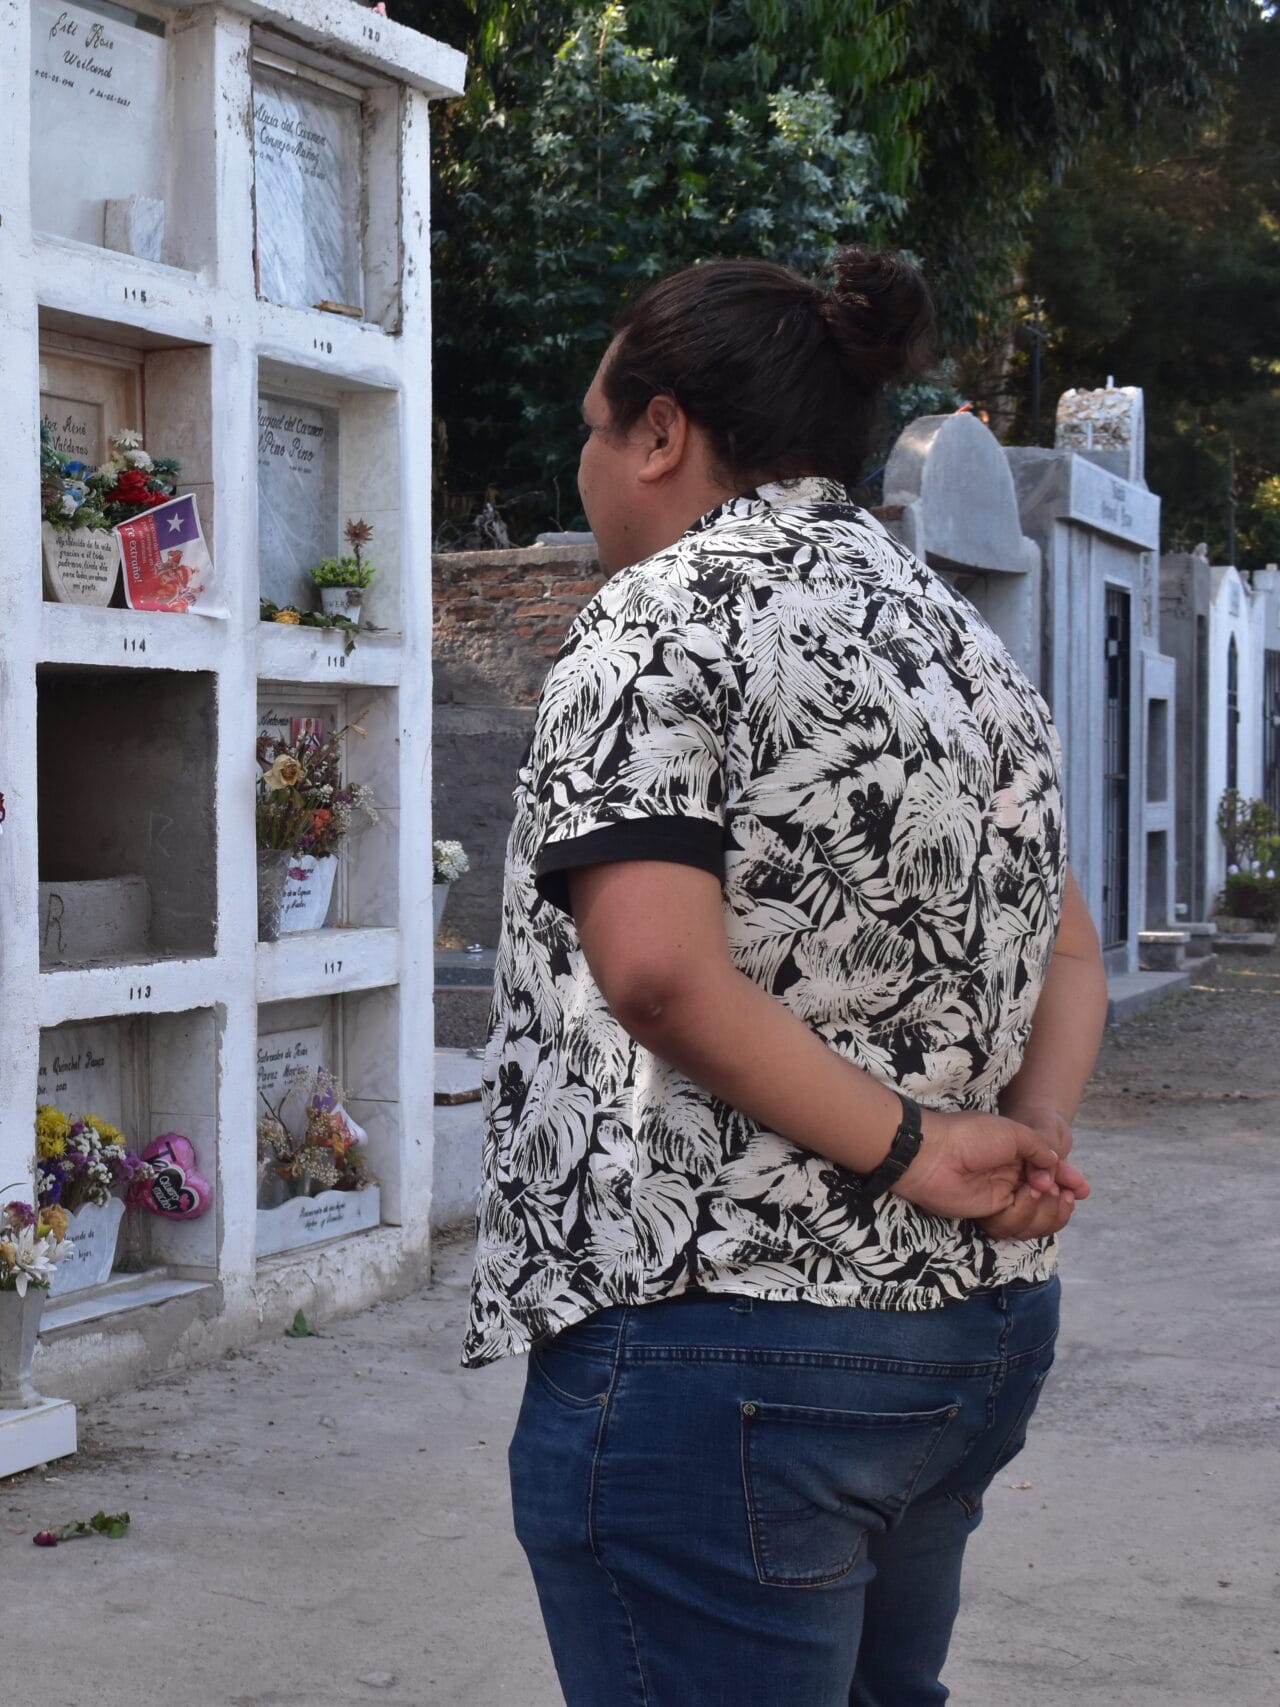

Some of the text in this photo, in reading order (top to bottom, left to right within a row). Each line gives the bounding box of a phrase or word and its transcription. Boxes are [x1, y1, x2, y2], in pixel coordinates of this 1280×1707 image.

[363, 24, 380, 42] 120
[124, 287, 147, 302] 115
[124, 637, 146, 652] 114
[324, 960, 344, 975] 117
[129, 985, 152, 1001] 113
